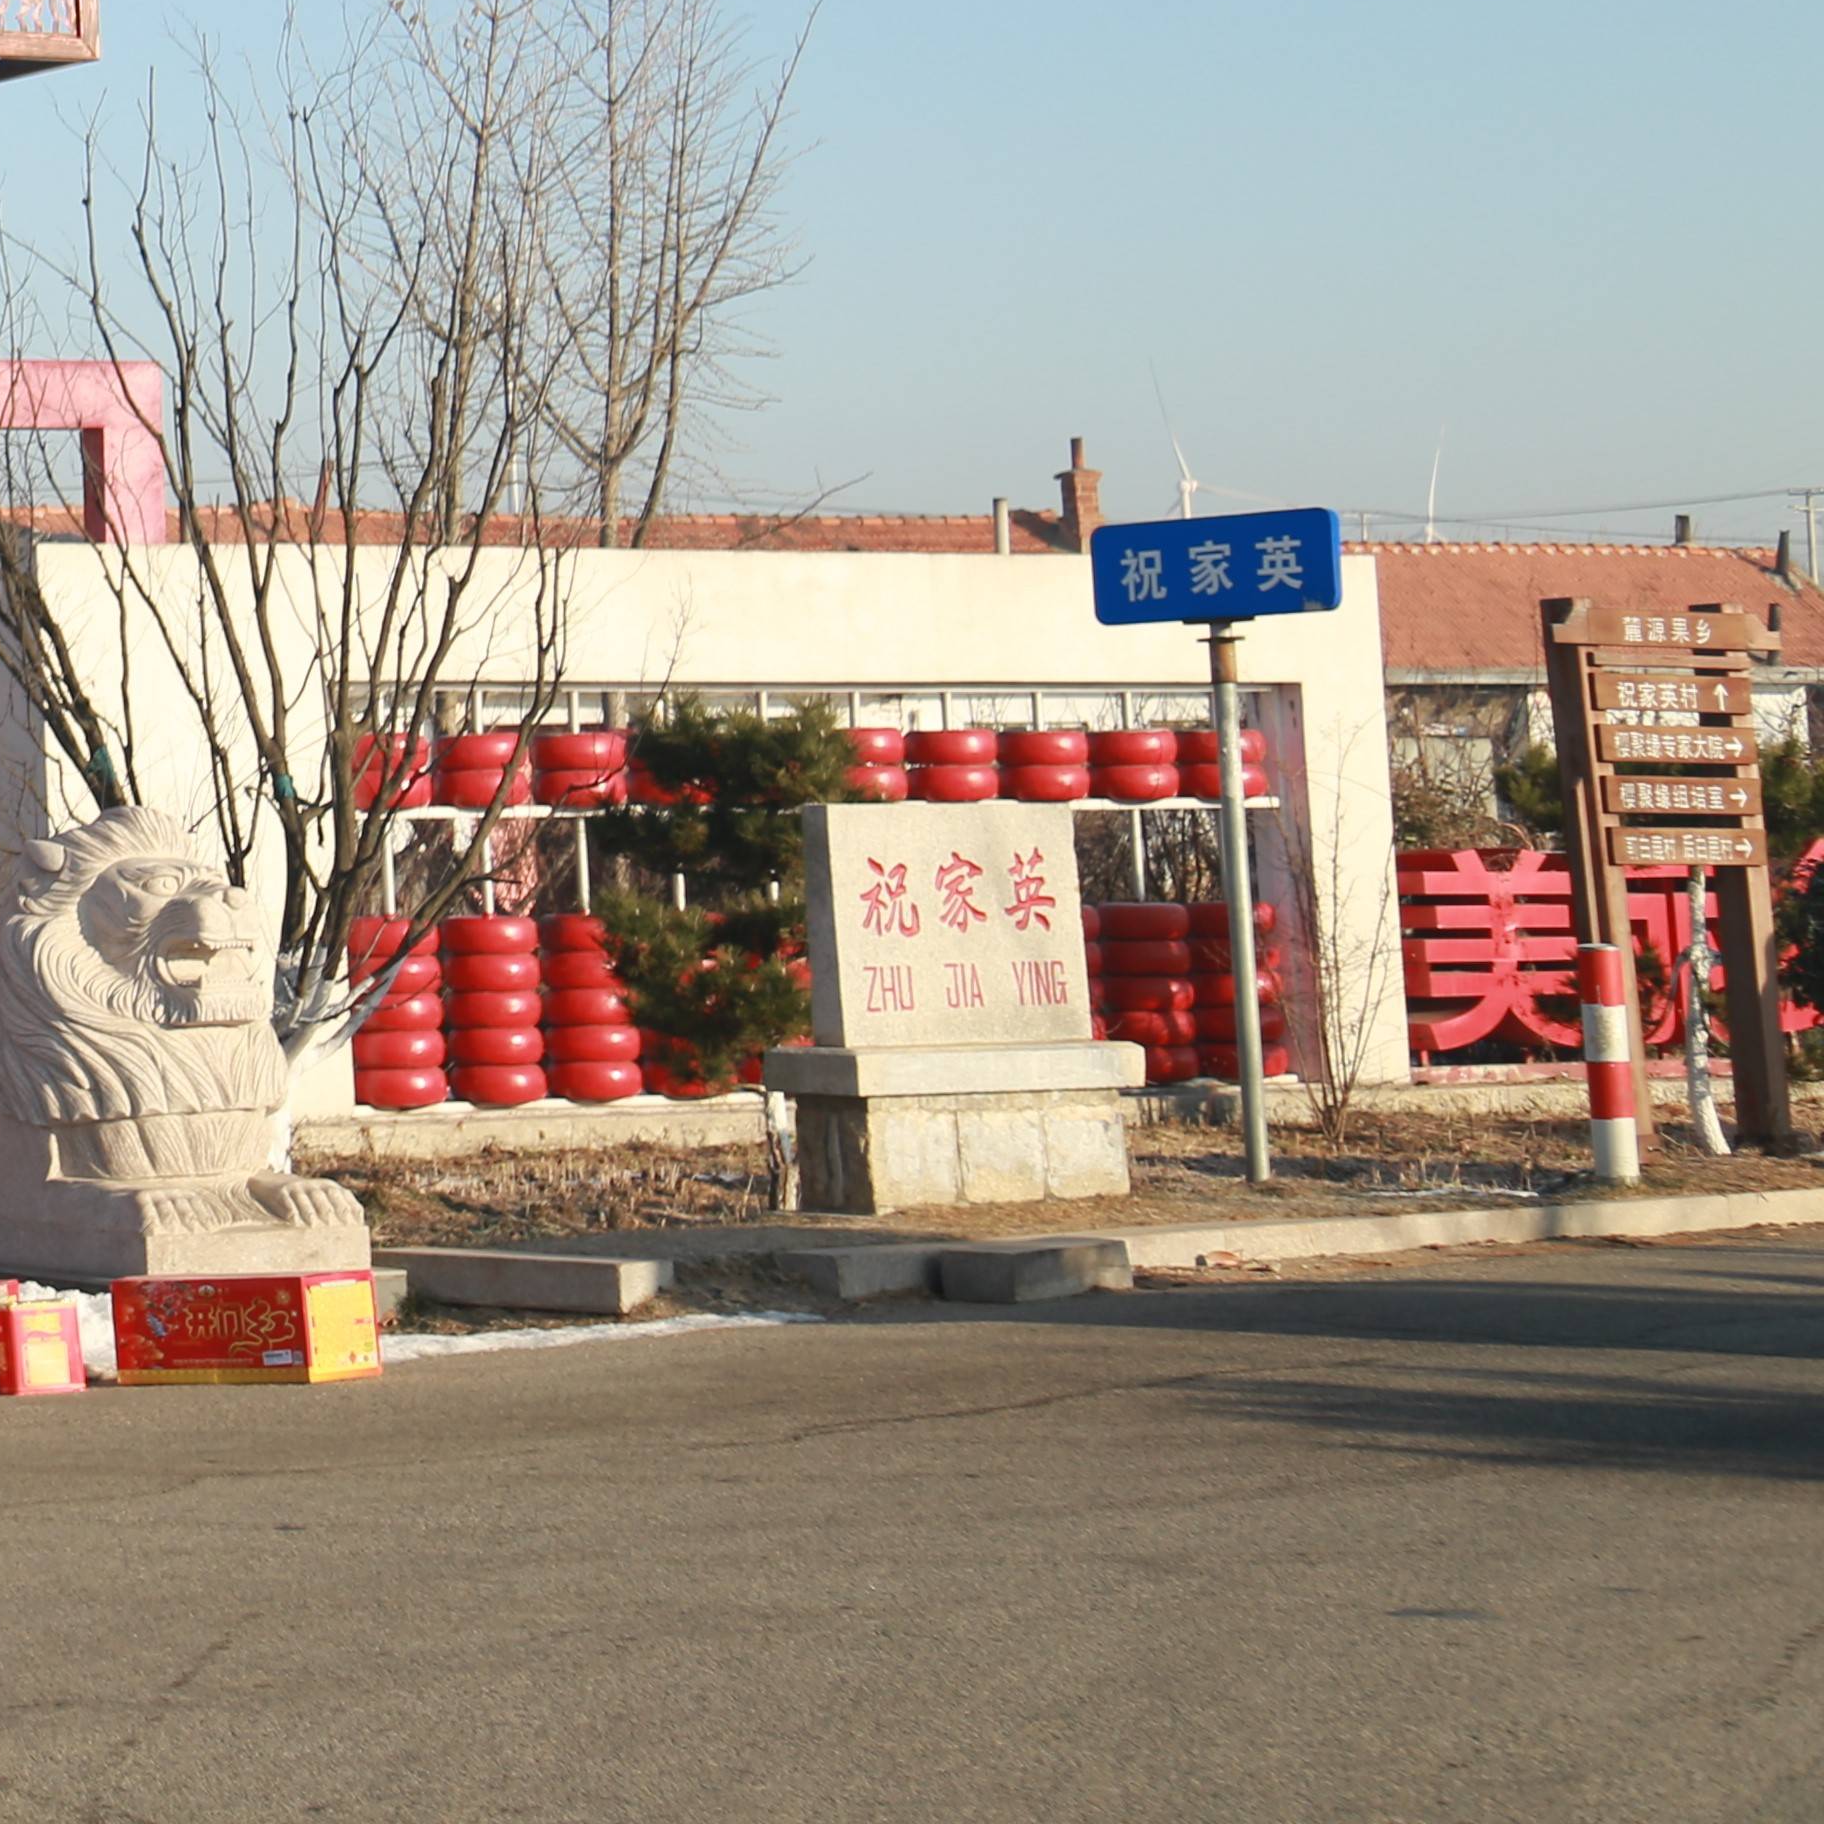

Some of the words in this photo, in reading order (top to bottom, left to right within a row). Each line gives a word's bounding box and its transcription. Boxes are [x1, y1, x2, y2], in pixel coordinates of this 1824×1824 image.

[1120, 536, 1303, 602] 祝家英
[1616, 681, 1700, 709] 祝家英村
[860, 847, 1056, 937] 祝家英
[863, 965, 915, 1012] ZHU
[944, 963, 984, 1008] JIA
[1011, 960, 1069, 1007] YING
